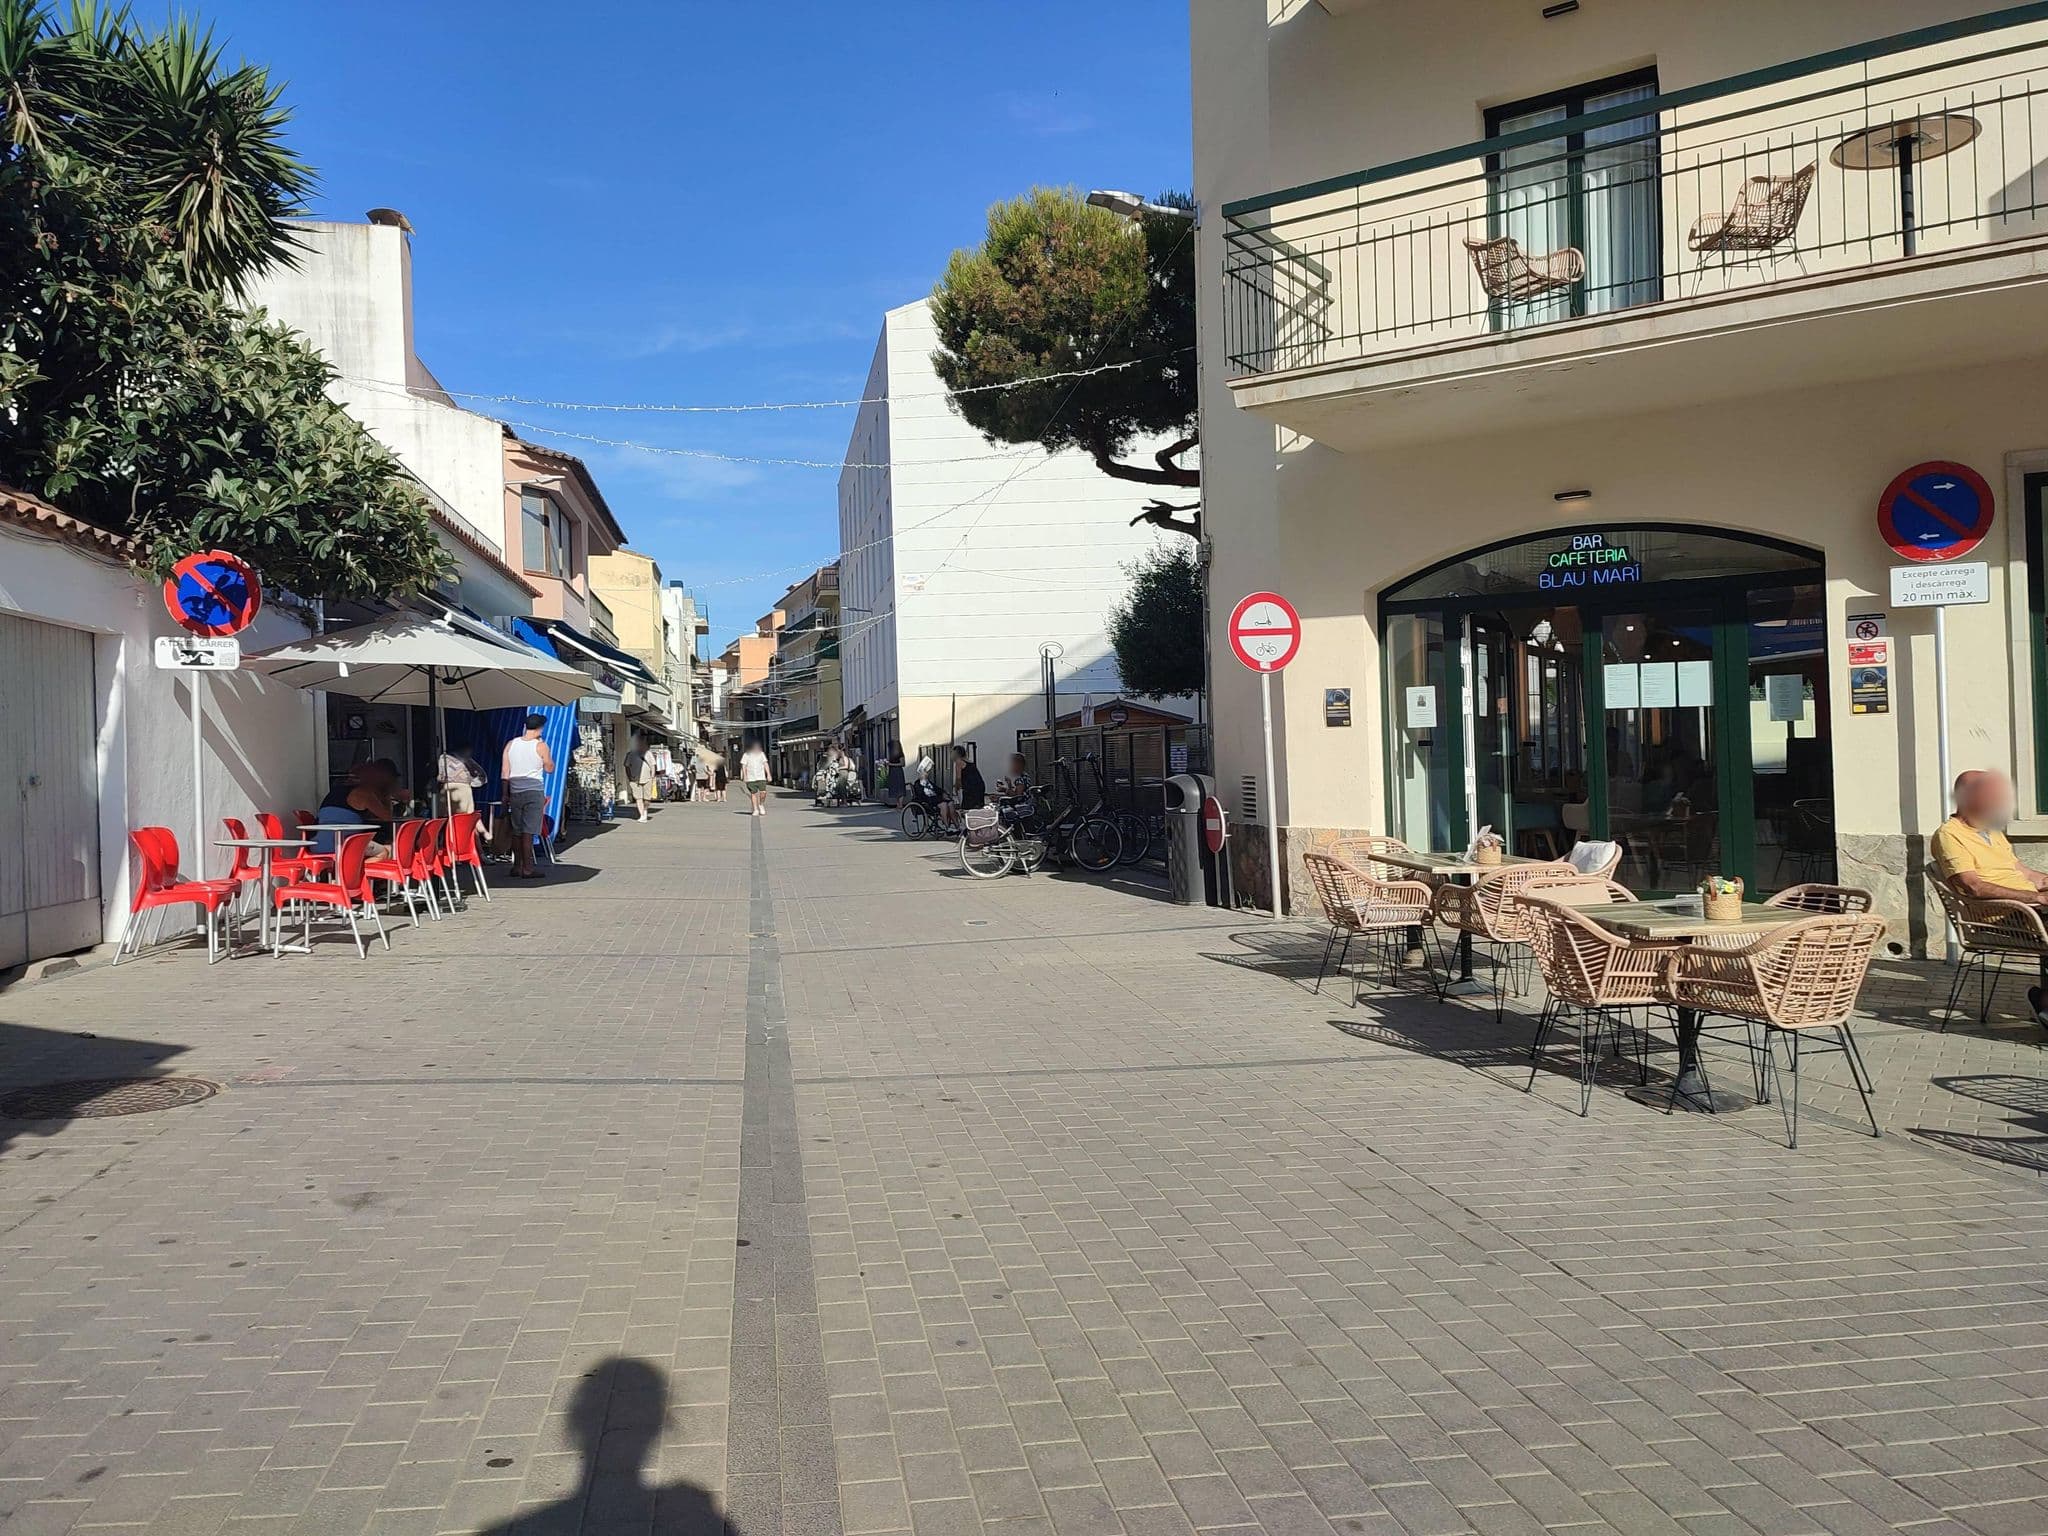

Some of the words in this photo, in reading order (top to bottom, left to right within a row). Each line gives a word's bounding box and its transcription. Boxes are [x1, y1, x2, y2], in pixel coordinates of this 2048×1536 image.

[1573, 534, 1602, 550] BAR
[1550, 548, 1628, 567] CAFETERIA
[1539, 571, 1586, 589] BLAU
[1593, 564, 1640, 584] MARÍ
[1940, 568, 1975, 576] càrrega
[1903, 593, 1917, 602] 20
[1920, 591, 1943, 601] min
